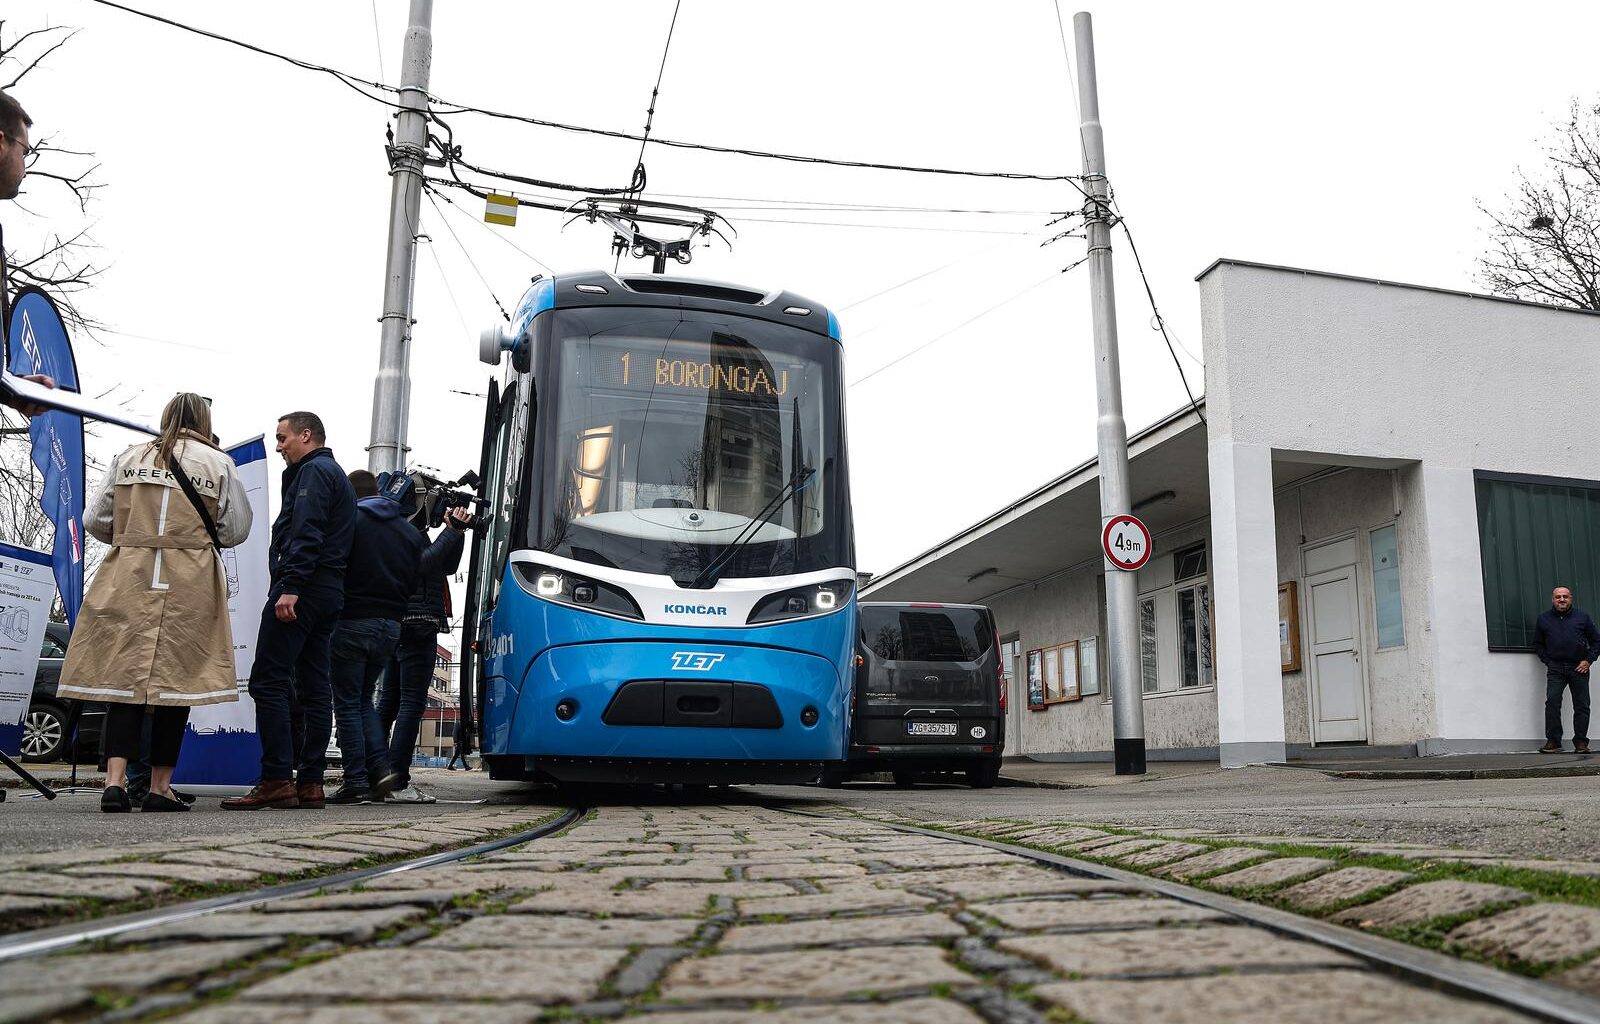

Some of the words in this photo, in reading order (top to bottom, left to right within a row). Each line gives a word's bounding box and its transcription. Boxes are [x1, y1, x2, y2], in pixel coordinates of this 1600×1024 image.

[621, 352, 630, 385] 1
[655, 358, 789, 396] BORONGAJ
[123, 468, 215, 490] WEEKND
[491, 633, 514, 659] 2401
[671, 651, 726, 671] ZET
[913, 723, 923, 733] ZG
[973, 728, 983, 737] HR
